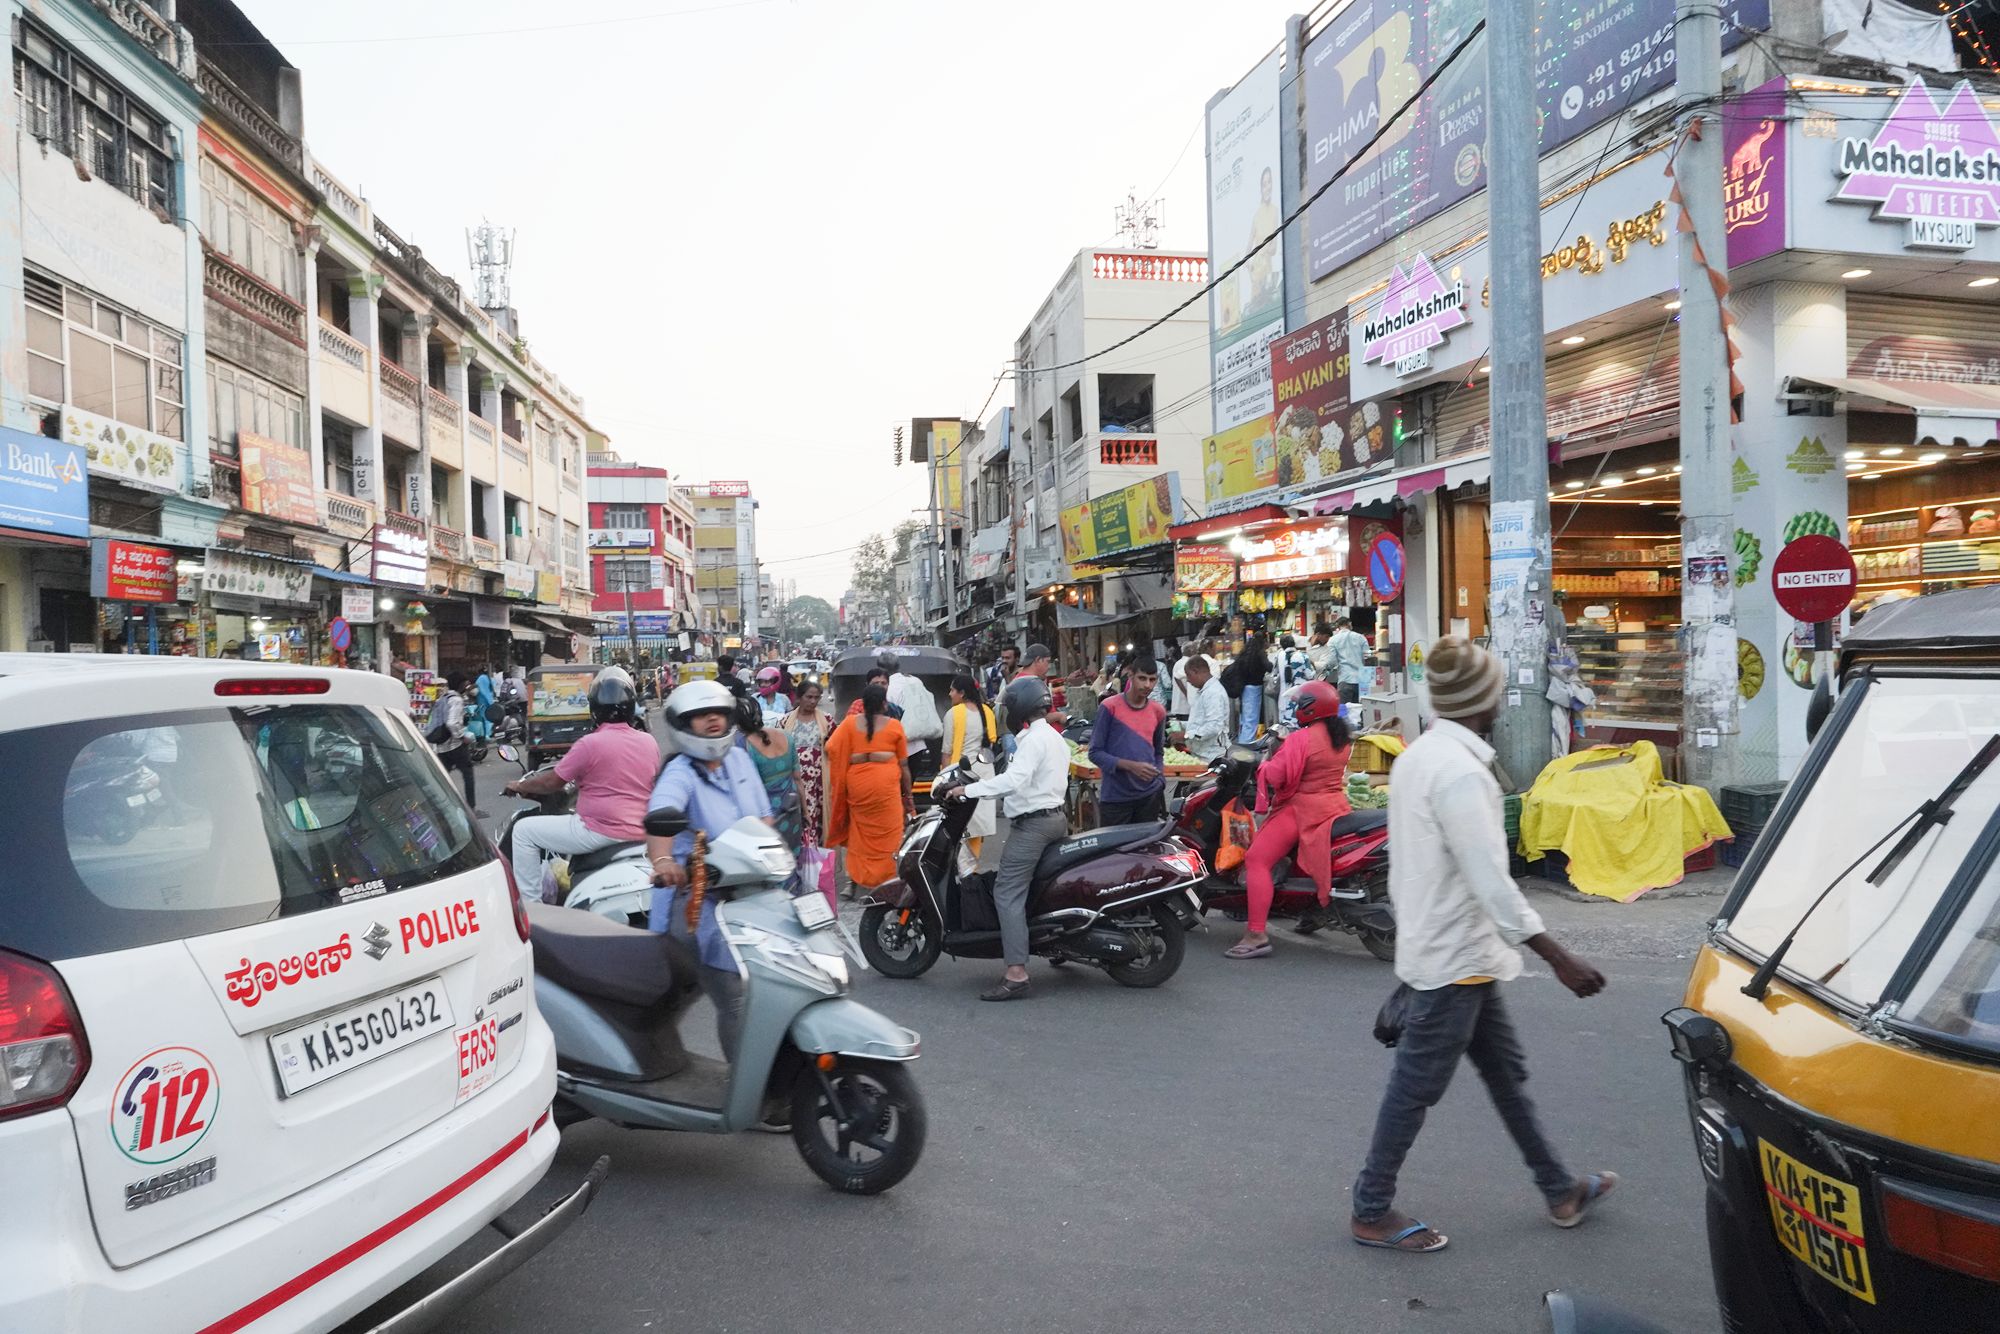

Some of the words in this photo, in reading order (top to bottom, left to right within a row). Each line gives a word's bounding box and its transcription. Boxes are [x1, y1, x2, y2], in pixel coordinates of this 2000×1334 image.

[1586, 58, 1616, 86] +91
[1586, 82, 1617, 110] +91
[1314, 101, 1380, 164] BHIMA
[1344, 151, 1409, 206] Properties
[1905, 191, 1984, 218] SWEETS
[1914, 224, 1973, 245] MYSURU
[1364, 282, 1461, 344] Mahalakshmi
[1392, 328, 1433, 358] SWEETS
[1396, 352, 1427, 373] MYSURU
[1277, 362, 1333, 402] BHAVANI
[8, 442, 57, 480] Bank
[410, 476, 419, 517] NOTARY
[710, 485, 748, 493] ROOMS
[1783, 575, 1801, 586] NO
[1804, 572, 1845, 584] ENTRY
[353, 879, 385, 893] GLOBE
[399, 899, 480, 955] POLICE
[224, 932, 352, 1008] ಪೊಲೀಸ್
[303, 991, 441, 1072] KA55G0432
[458, 1018, 497, 1079] ERSS
[138, 1067, 210, 1152] 112
[129, 1115, 143, 1152] Namma
